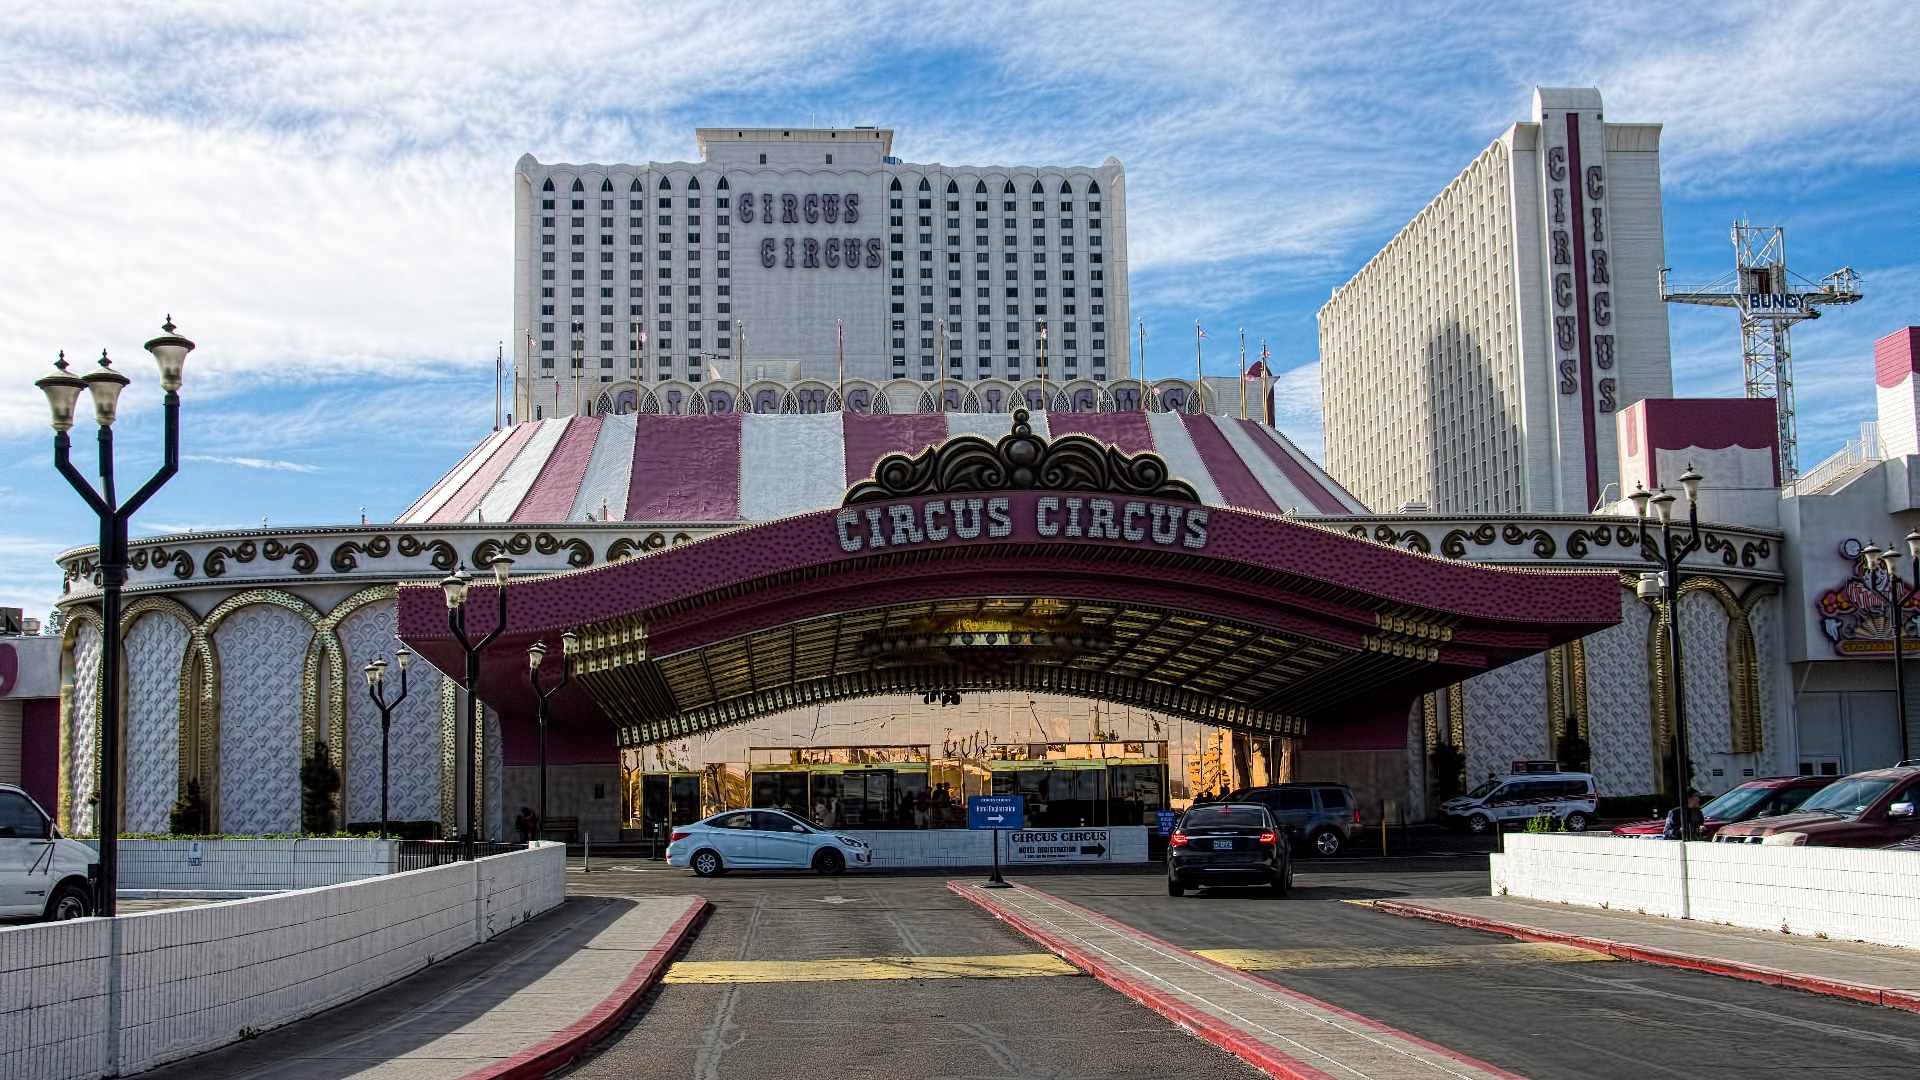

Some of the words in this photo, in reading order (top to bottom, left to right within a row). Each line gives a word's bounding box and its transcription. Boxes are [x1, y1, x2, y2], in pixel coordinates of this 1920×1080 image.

[740, 193, 859, 224] CIRCUS
[761, 238, 881, 268] CIRCUS
[1548, 146, 1577, 395] CIRCUS
[1587, 165, 1616, 413] CIRCUS
[1750, 293, 1806, 309] BUNGY
[836, 498, 1012, 551] CIRCUS
[1036, 497, 1208, 548] CIRCUS
[1011, 832, 1058, 843] CIRCUS
[1060, 831, 1107, 842] CIRCUS
[1018, 846, 1036, 854] HOTEL
[1037, 845, 1077, 853] REGISTRATION
